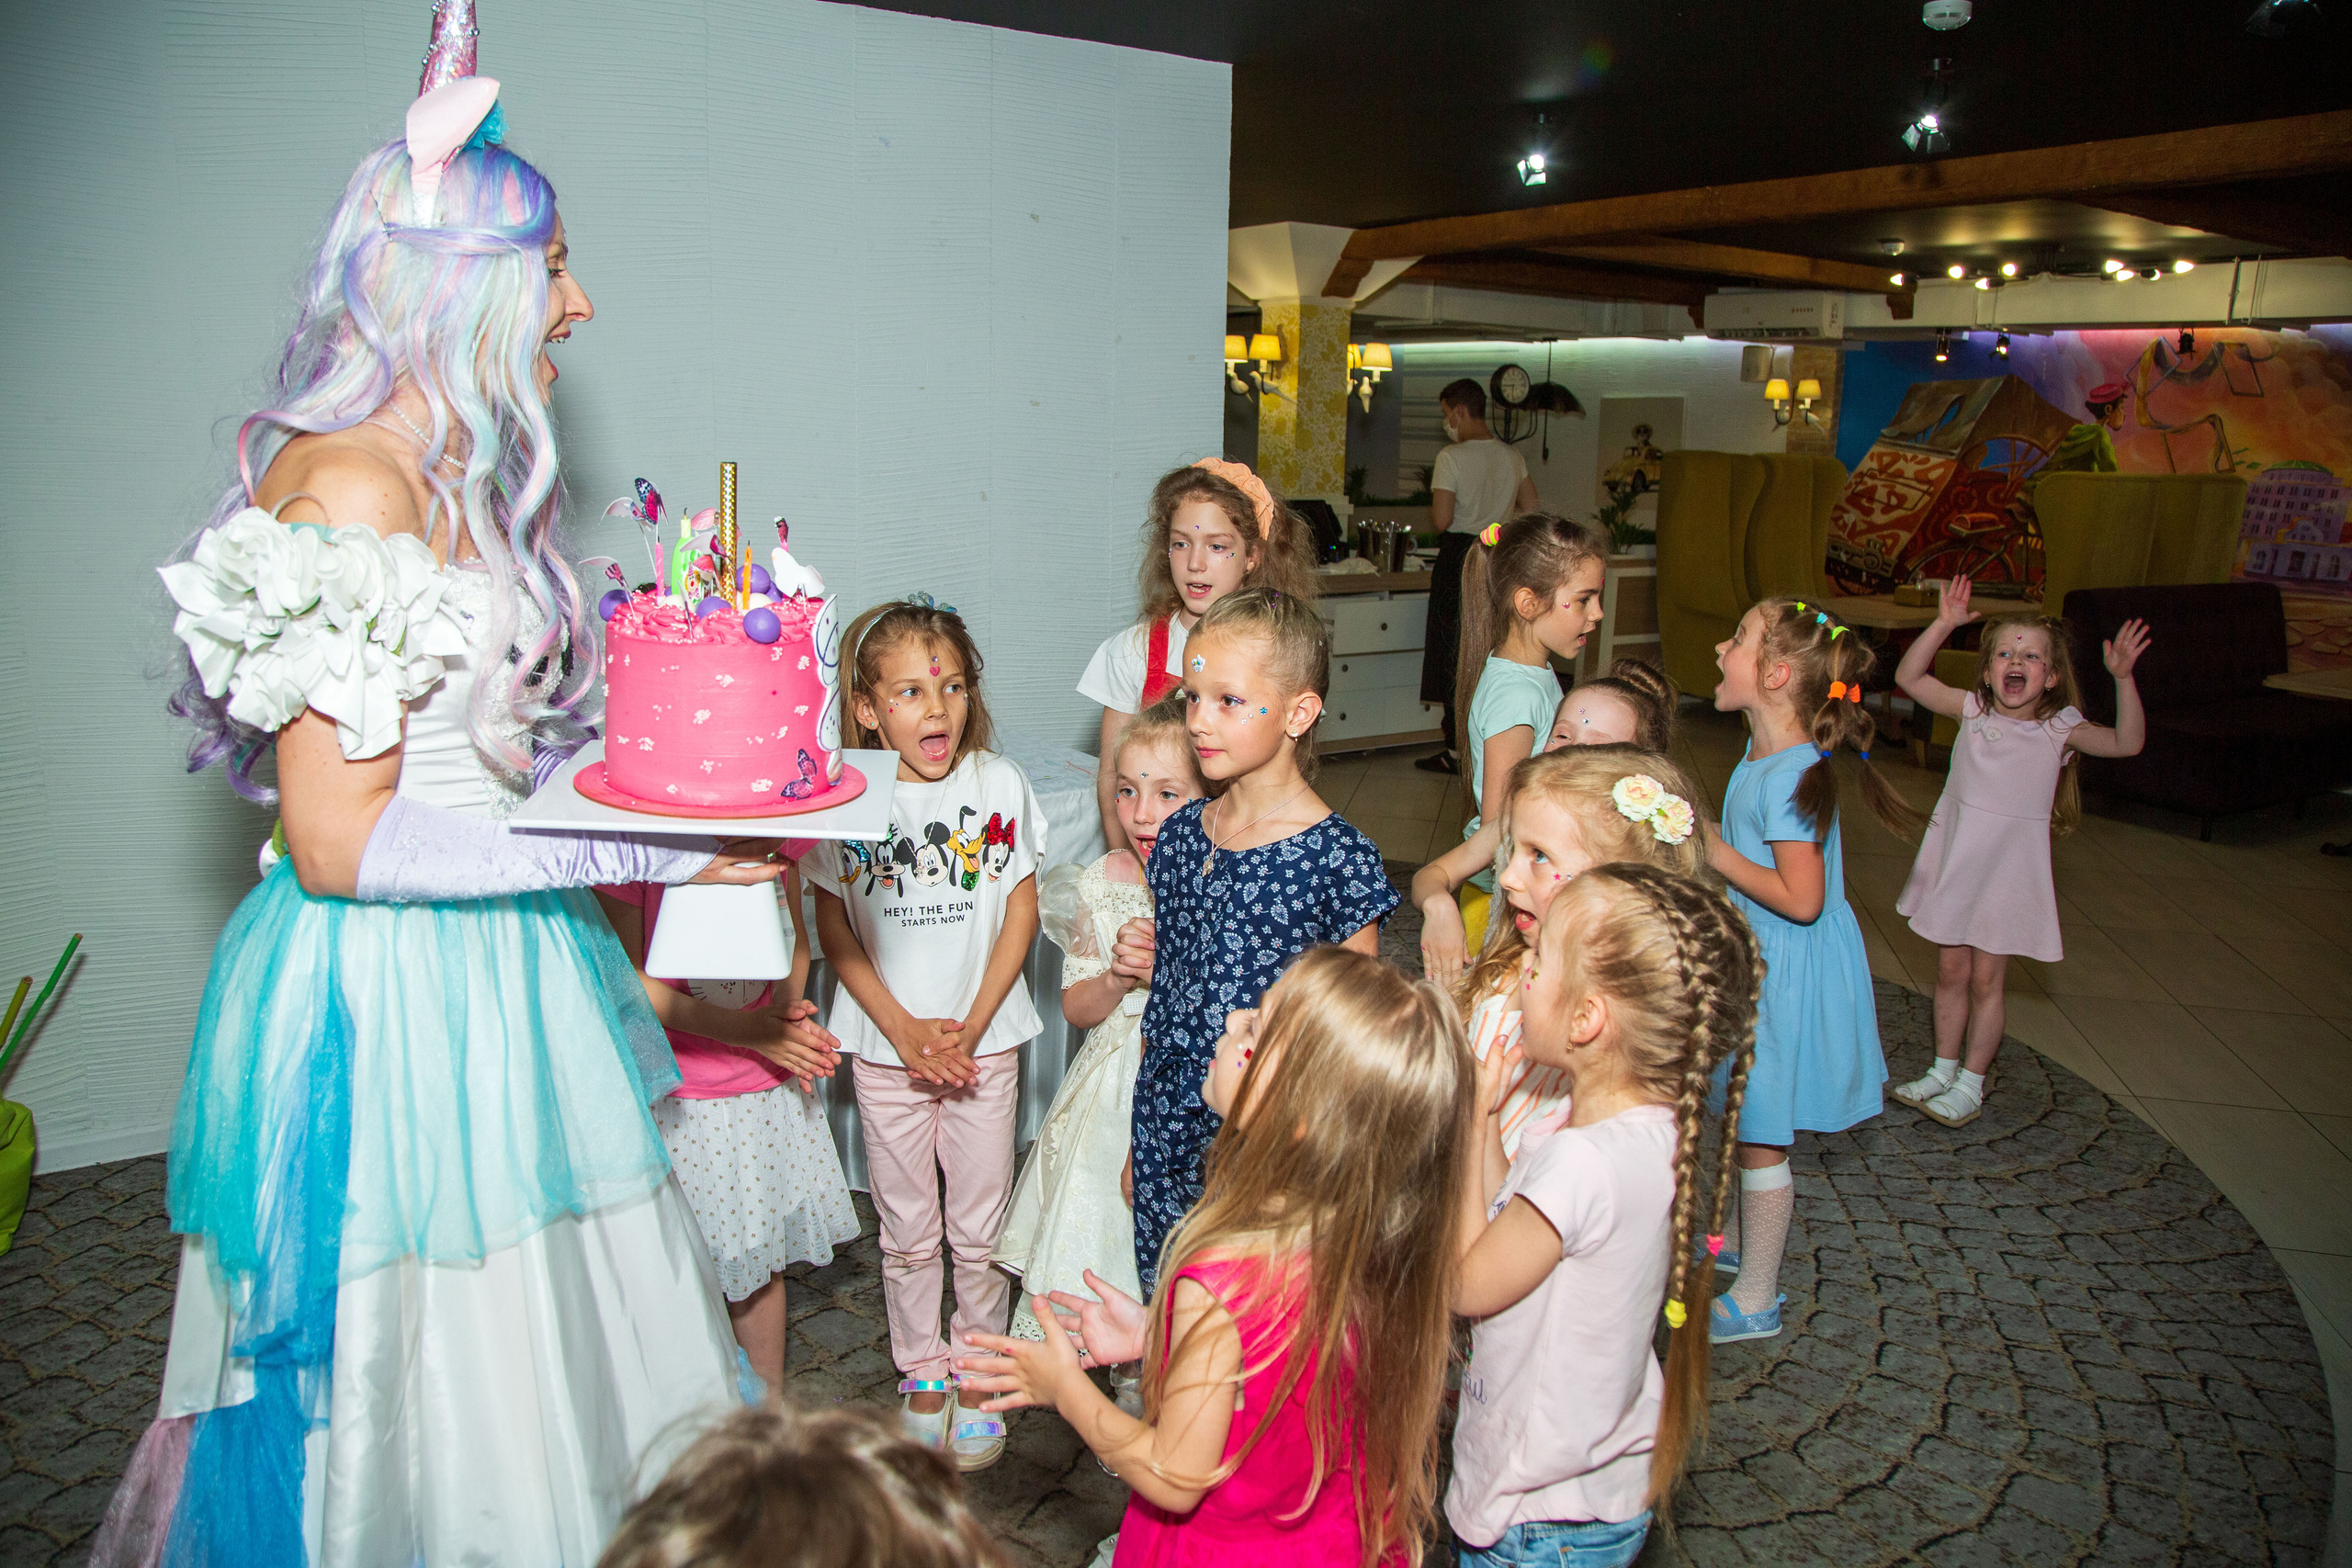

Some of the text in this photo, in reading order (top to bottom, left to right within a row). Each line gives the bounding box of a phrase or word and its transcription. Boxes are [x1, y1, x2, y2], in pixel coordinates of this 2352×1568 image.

[884, 901, 974, 918] HEY! THE FUN
[901, 914, 966, 927] STARTS NOW
